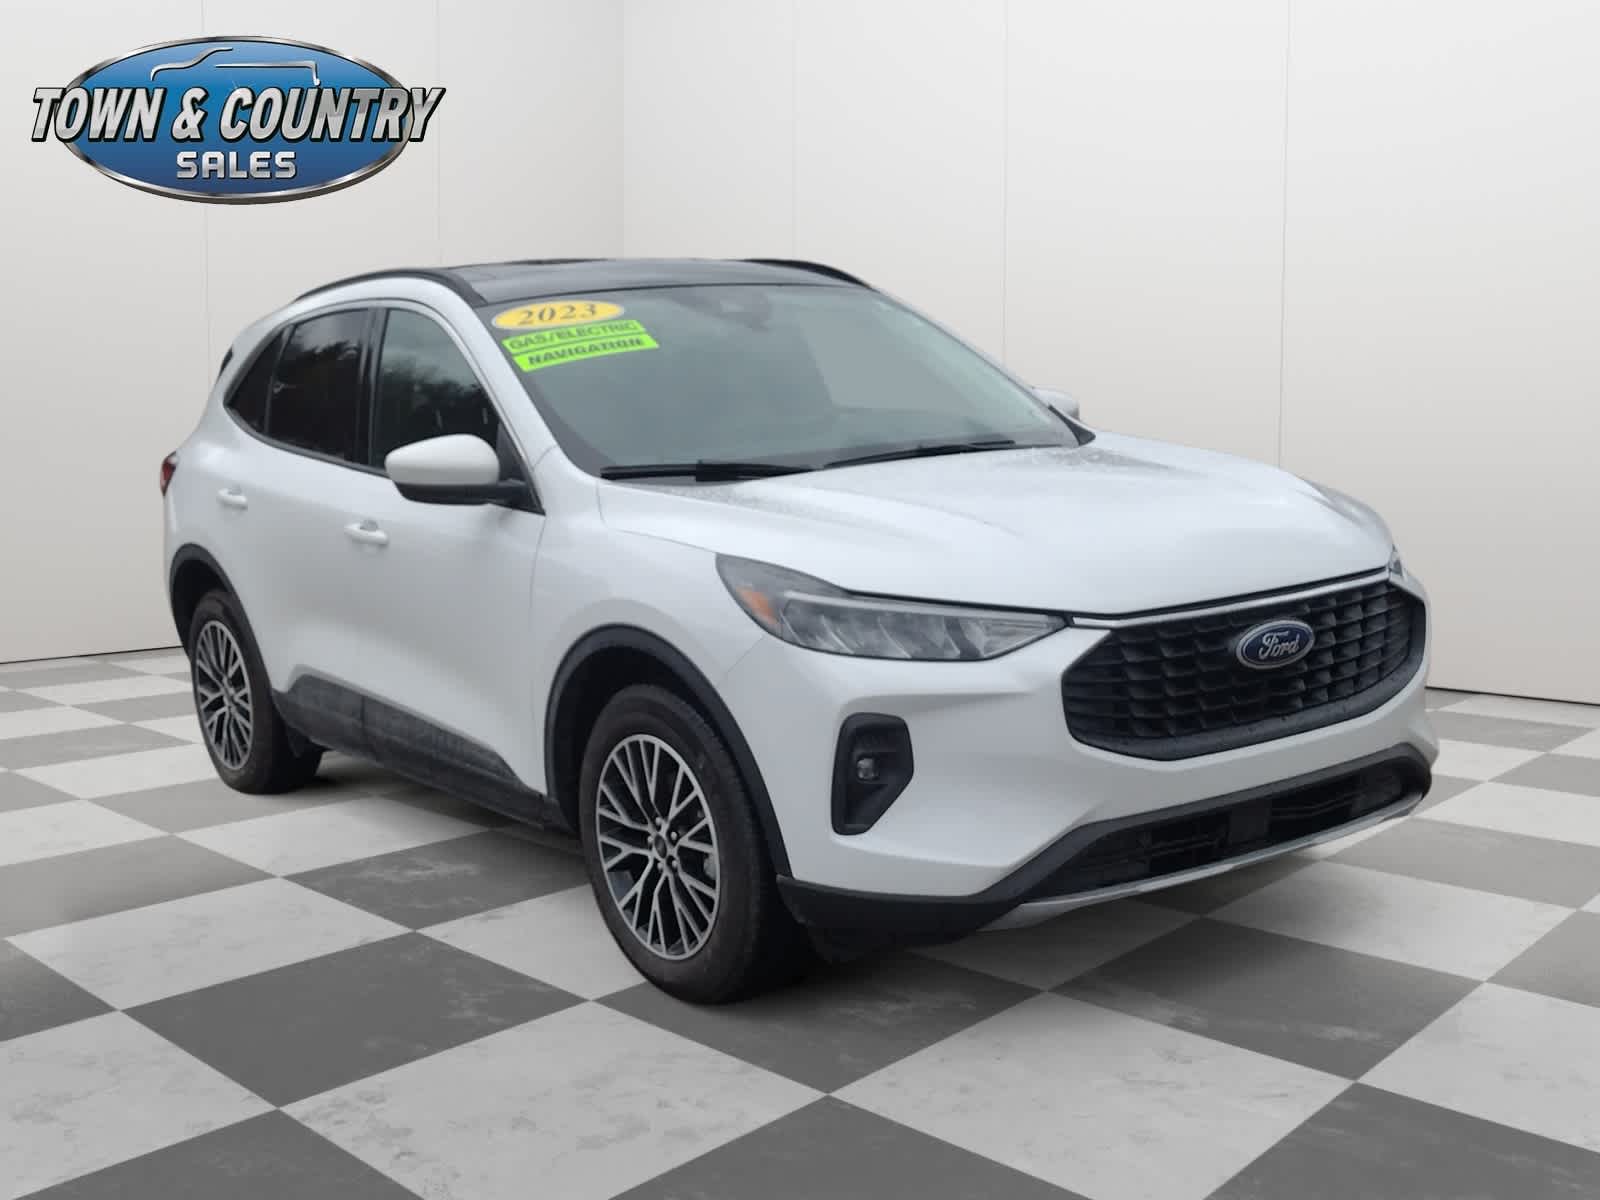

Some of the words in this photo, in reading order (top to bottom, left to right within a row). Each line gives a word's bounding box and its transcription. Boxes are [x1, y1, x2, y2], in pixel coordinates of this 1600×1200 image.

[517, 303, 597, 326] 2023
[509, 322, 640, 350] GAS/ELECTRIC
[528, 337, 644, 366] NAVIGATION
[1258, 630, 1300, 660] Ford
